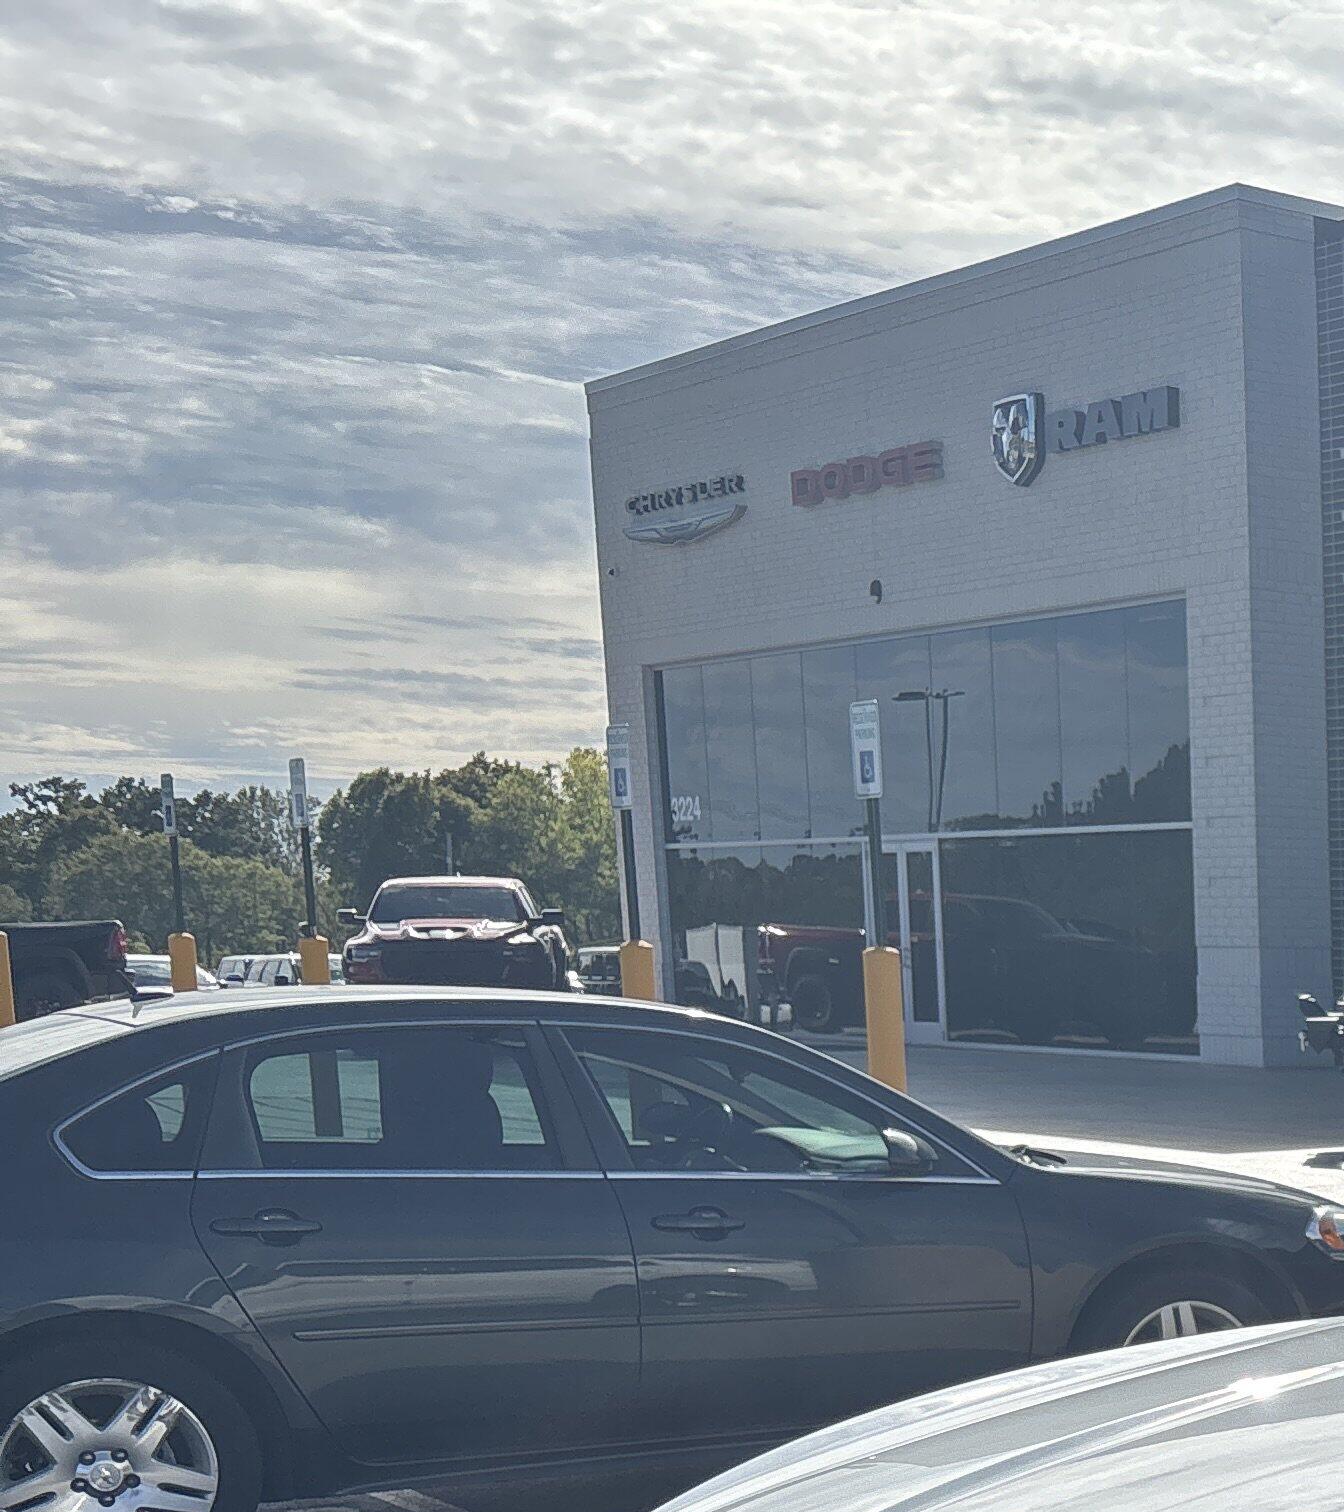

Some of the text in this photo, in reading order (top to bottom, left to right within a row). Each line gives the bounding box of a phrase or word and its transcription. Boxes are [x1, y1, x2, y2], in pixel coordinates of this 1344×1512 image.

[1046, 386, 1180, 453] RAM
[791, 440, 945, 508] DODGE
[671, 796, 701, 822] 3224
